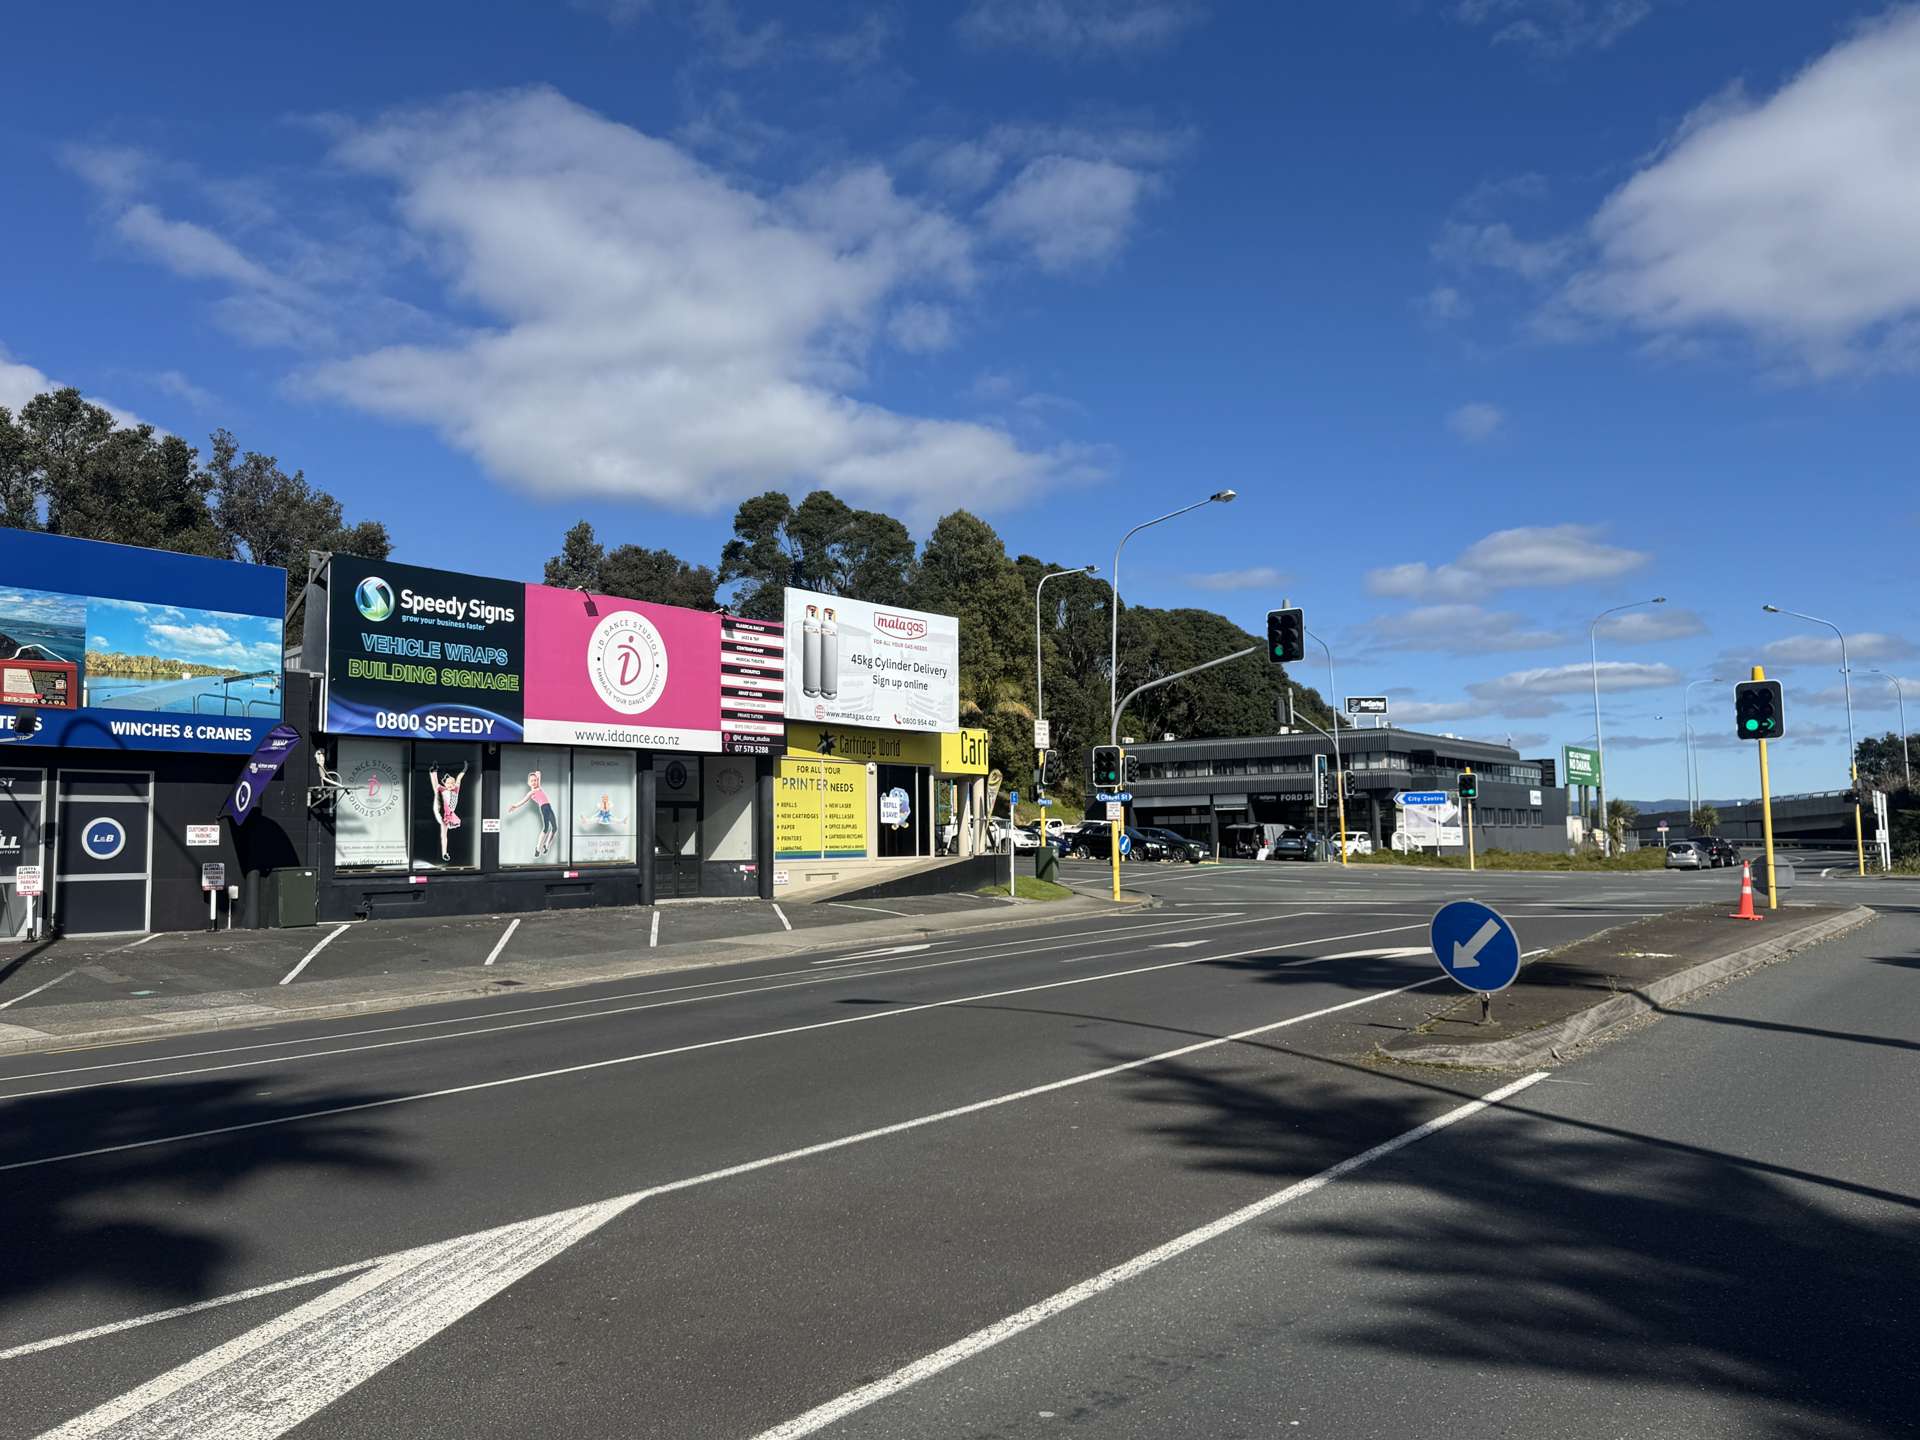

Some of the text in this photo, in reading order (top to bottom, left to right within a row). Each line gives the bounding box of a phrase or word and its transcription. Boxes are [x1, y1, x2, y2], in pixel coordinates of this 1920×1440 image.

[400, 588, 515, 625] Speedy Signs
[401, 615, 486, 631] grow your business faster
[603, 619, 629, 637] DANCE
[633, 621, 659, 656] STUDIOS
[361, 632, 509, 666] VEHICLE WRAPS
[348, 658, 520, 692] BUILDING SIGNAGE
[850, 654, 948, 679] 45kg Cylinder Delivery
[872, 674, 928, 691] Sign up online
[613, 694, 627, 704] YOUR
[628, 696, 646, 706] DANCE
[375, 711, 496, 735] 0800 SPEEDY
[826, 710, 881, 722] www.matagas.co.nz
[902, 717, 917, 725] 0800
[110, 721, 252, 741] WINCHES & CRANES
[575, 729, 680, 746] www.iddance.co.nz
[735, 744, 743, 752] 07
[743, 745, 754, 753] 578
[839, 734, 901, 758] Cartridge World
[960, 730, 989, 765] Cart
[796, 765, 841, 775] FOR ALL YOUR
[781, 777, 854, 793] PRINTER NEEDS
[1100, 793, 1120, 801] Chapel
[1280, 793, 1303, 801] FORD
